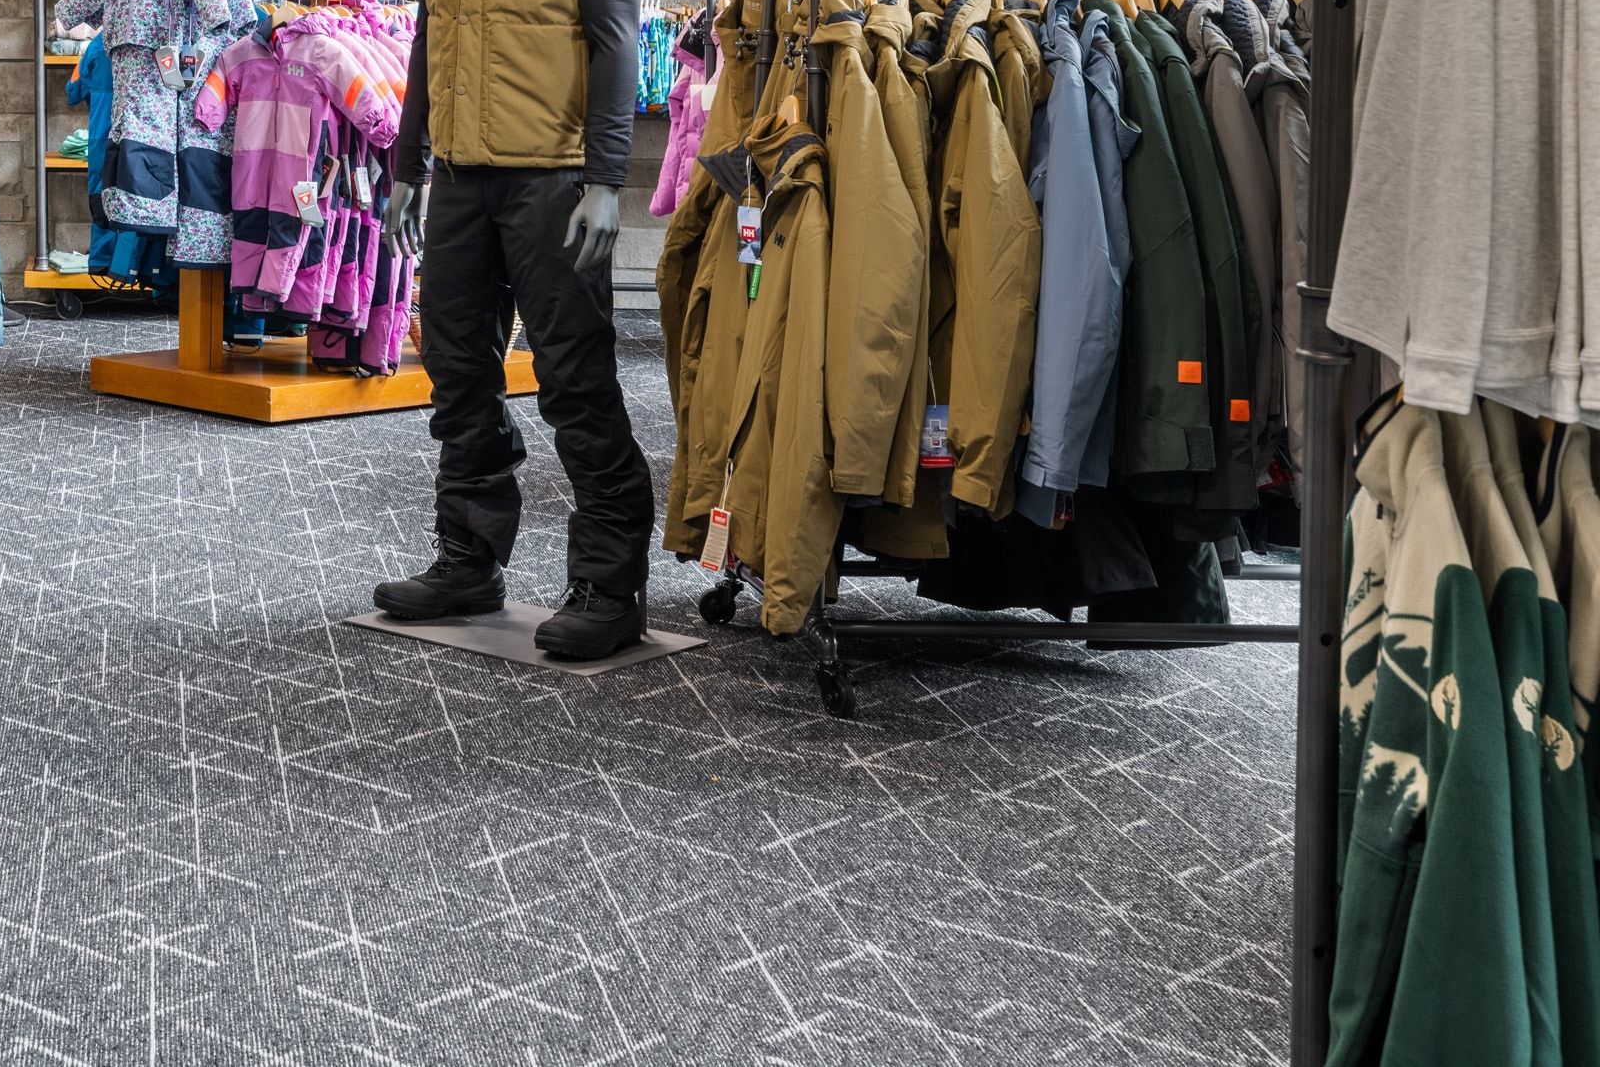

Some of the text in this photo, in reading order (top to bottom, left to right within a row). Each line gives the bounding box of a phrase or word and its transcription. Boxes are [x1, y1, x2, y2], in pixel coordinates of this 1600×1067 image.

[287, 63, 305, 78] HH
[743, 228, 756, 238] HH
[774, 232, 786, 249] HH
